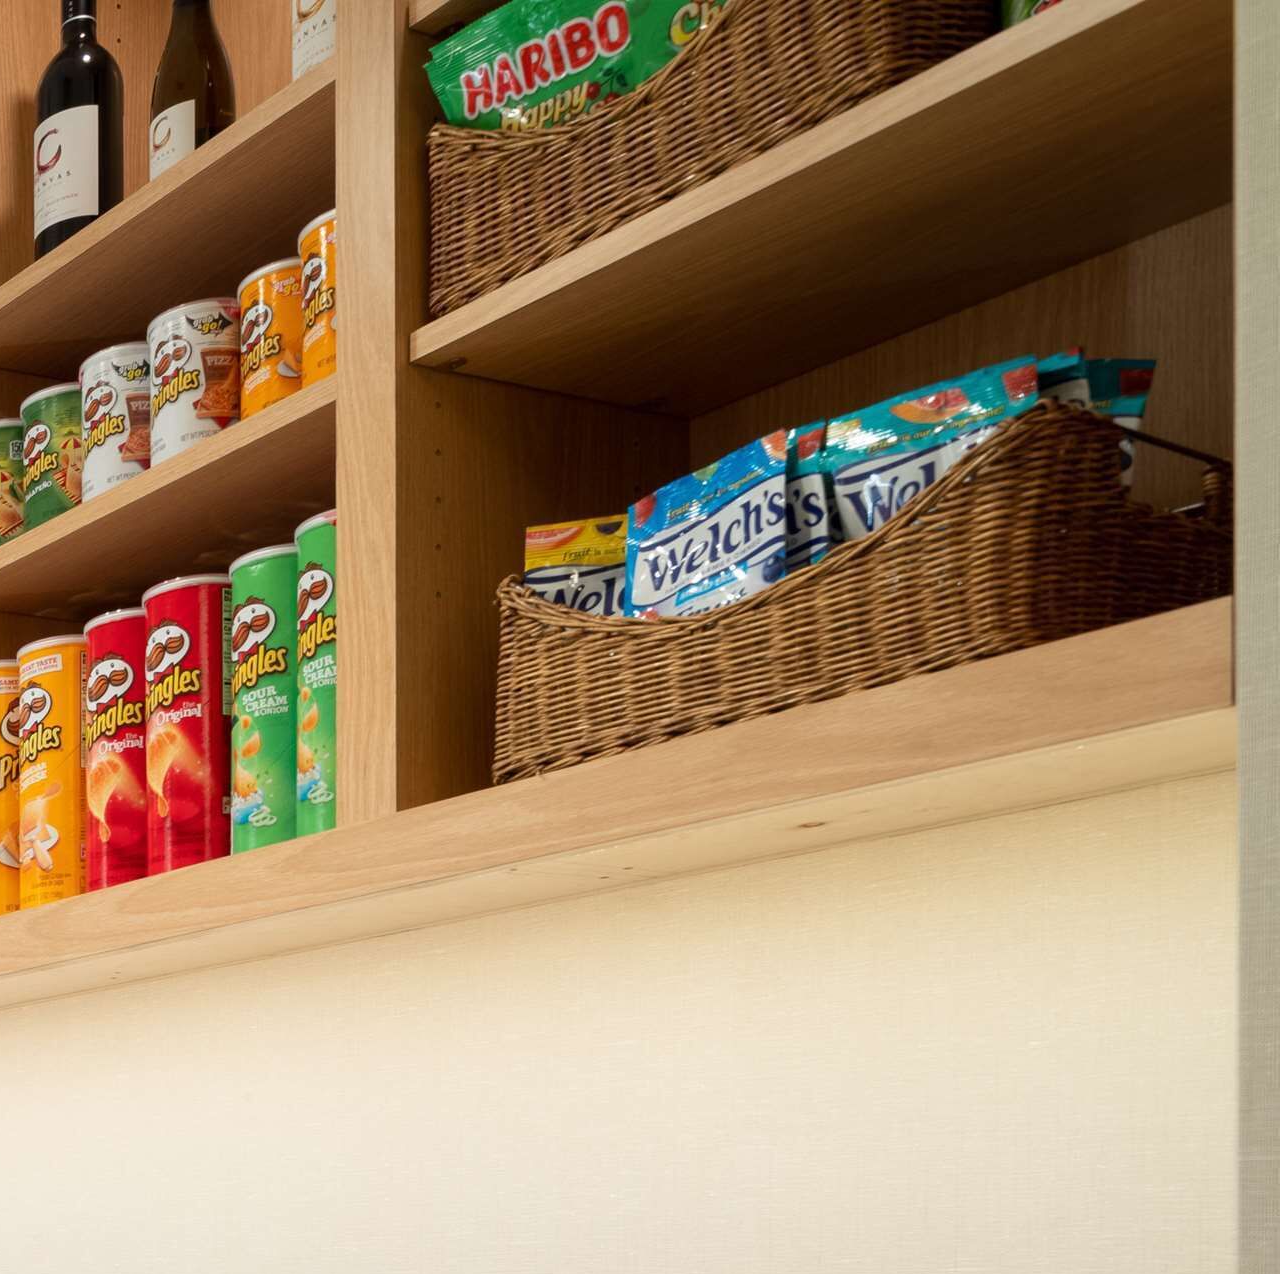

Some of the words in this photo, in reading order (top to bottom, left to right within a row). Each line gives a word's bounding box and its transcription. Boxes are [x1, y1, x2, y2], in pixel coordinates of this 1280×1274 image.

[460, 5, 630, 118] HARIBO
[644, 490, 785, 592] Welch's
[303, 654, 334, 676] SOUR
[242, 686, 277, 706] SOUR
[246, 695, 288, 714] CREAM
[156, 706, 202, 726] Original
[99, 736, 144, 755] Original
